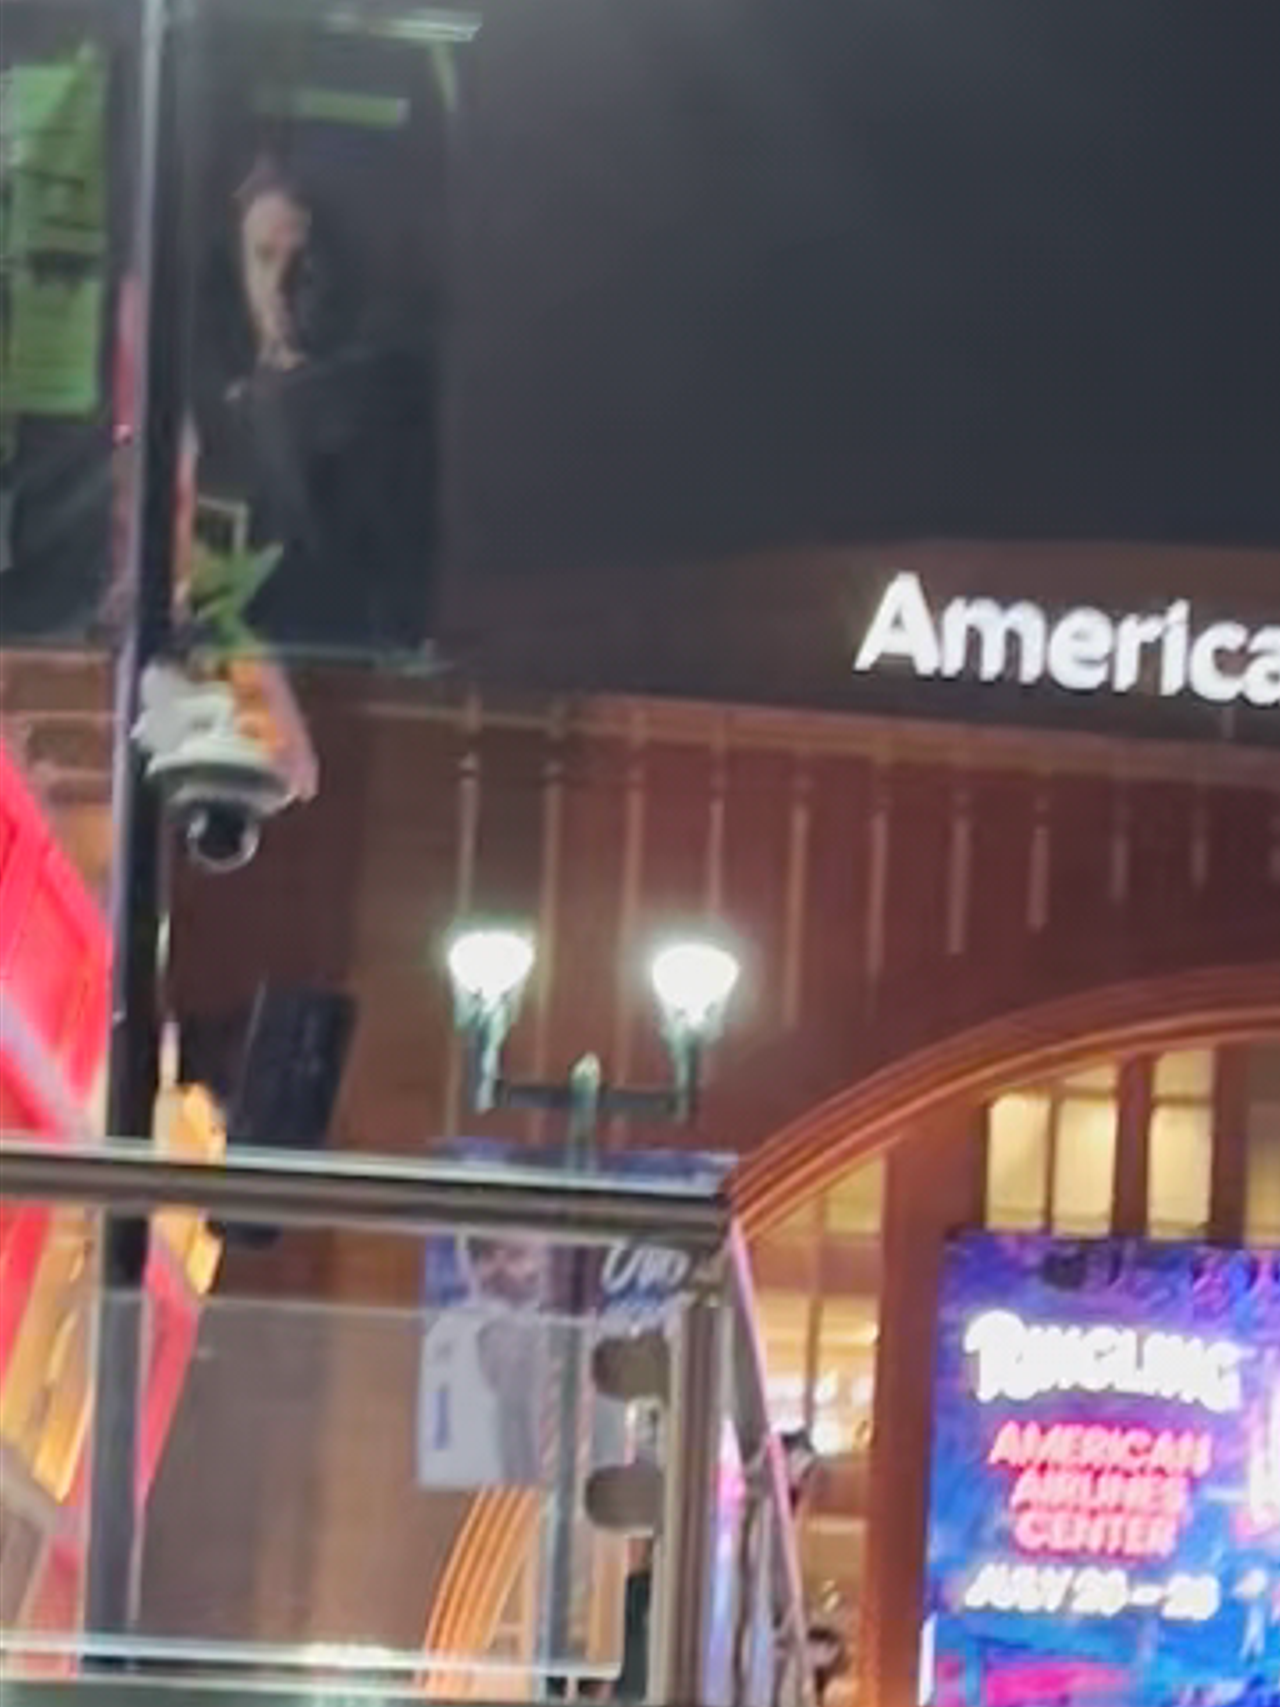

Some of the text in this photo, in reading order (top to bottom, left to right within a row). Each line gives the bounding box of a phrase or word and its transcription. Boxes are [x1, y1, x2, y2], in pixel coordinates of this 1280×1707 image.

[987, 1419, 1214, 1478] AMERICAN
[1010, 1467, 1190, 1515] AIRLINES
[1012, 1511, 1179, 1557] CENTER
[963, 1562, 1074, 1612] JULY
